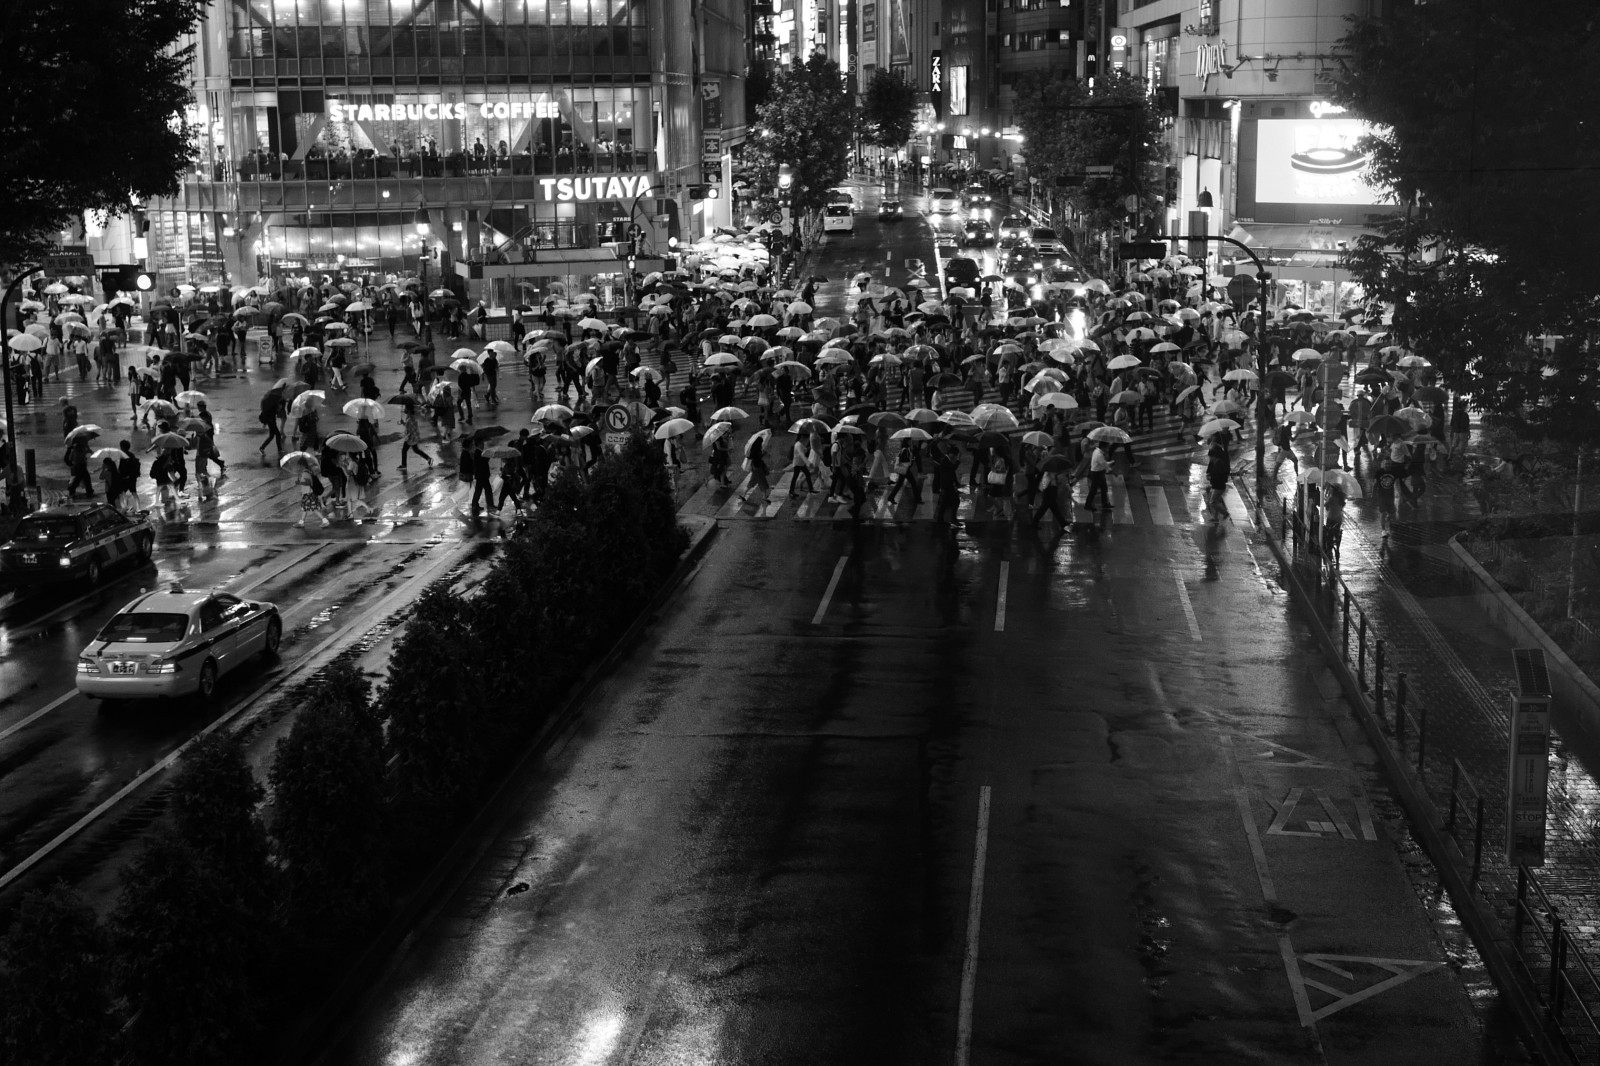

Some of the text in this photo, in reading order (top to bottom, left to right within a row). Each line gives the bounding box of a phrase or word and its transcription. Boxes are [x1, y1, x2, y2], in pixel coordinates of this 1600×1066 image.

[931, 56, 941, 92] ZARA
[330, 102, 559, 121] STARBUCKS COFFEE
[706, 139, 718, 153] 本
[953, 135, 968, 149] ZARA
[539, 175, 653, 201] TSUTAYA
